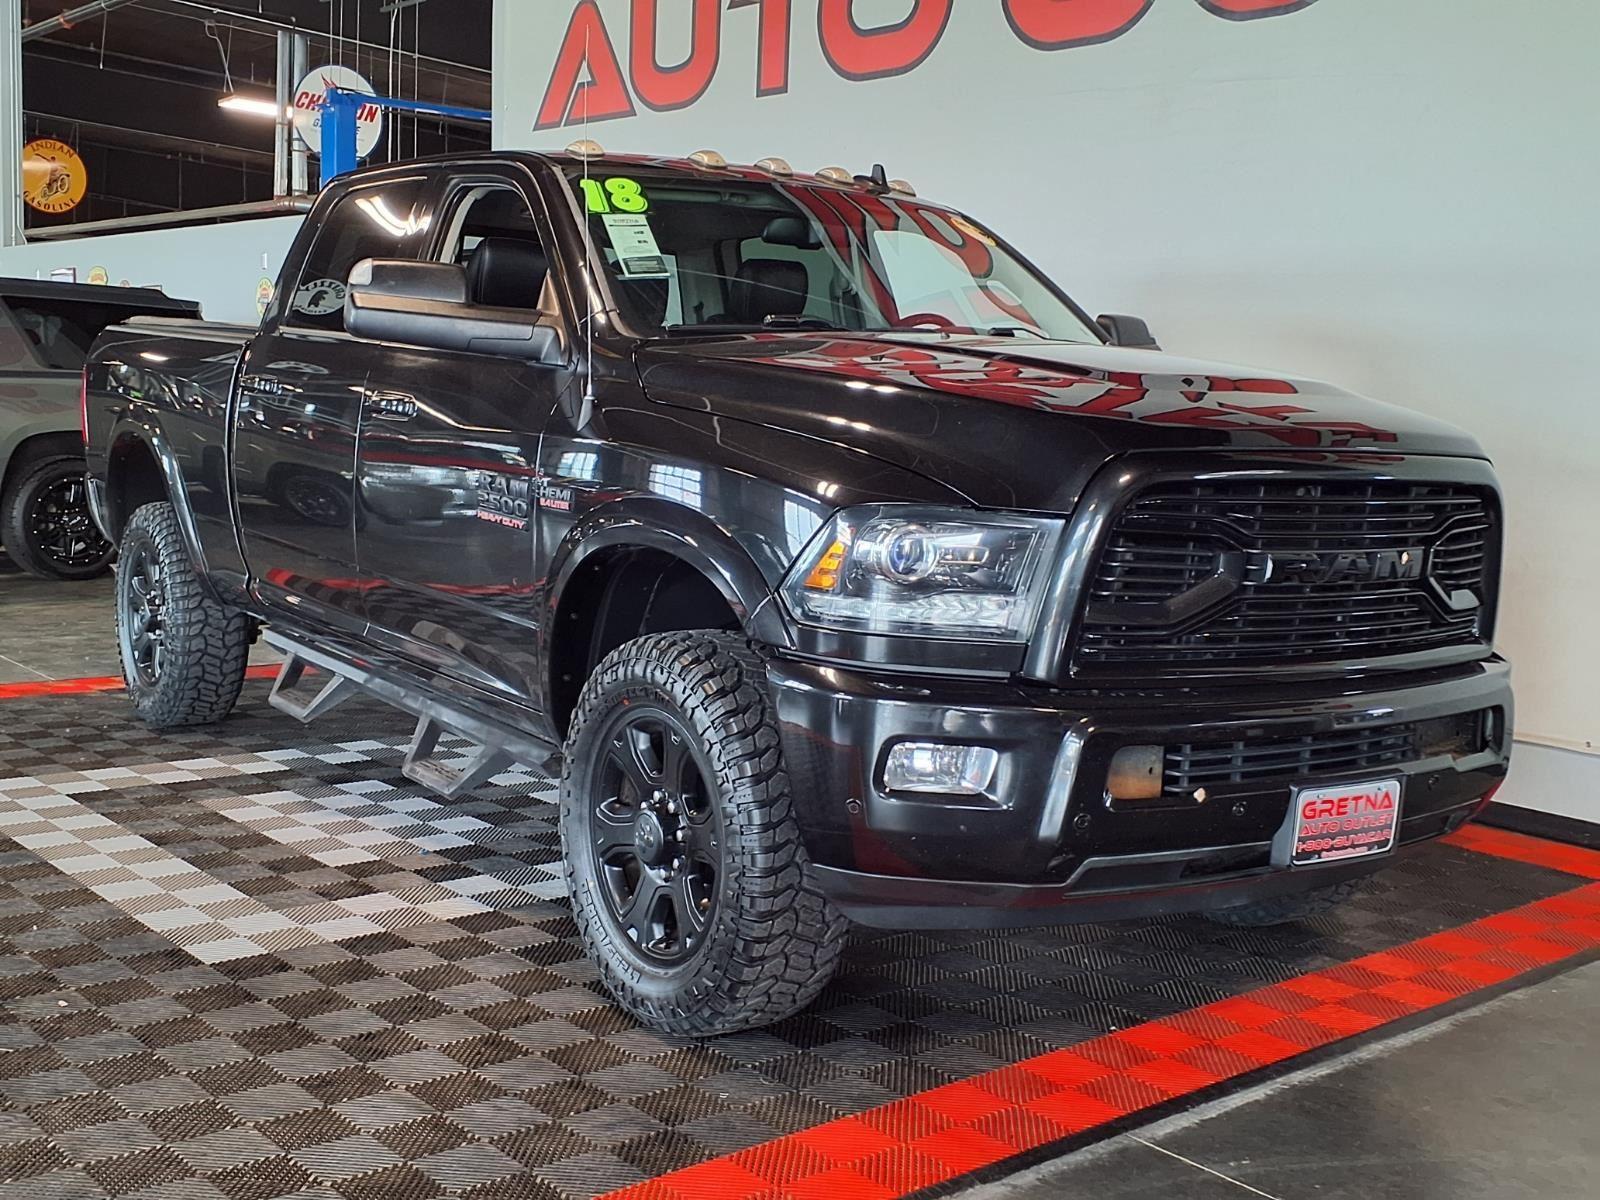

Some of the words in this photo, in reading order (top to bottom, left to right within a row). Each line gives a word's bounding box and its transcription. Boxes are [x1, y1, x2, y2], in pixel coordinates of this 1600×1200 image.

[31, 141, 76, 159] INDIAN
[23, 190, 77, 211] GASOLINE
[580, 177, 648, 213] 18
[478, 472, 528, 498] RAM
[540, 486, 571, 501] HEMI
[477, 490, 528, 518] 2500
[1265, 548, 1424, 584] RAM
[1302, 790, 1394, 820] GRETNA
[1299, 819, 1340, 836] AUTO
[1343, 813, 1393, 831] OUTLET
